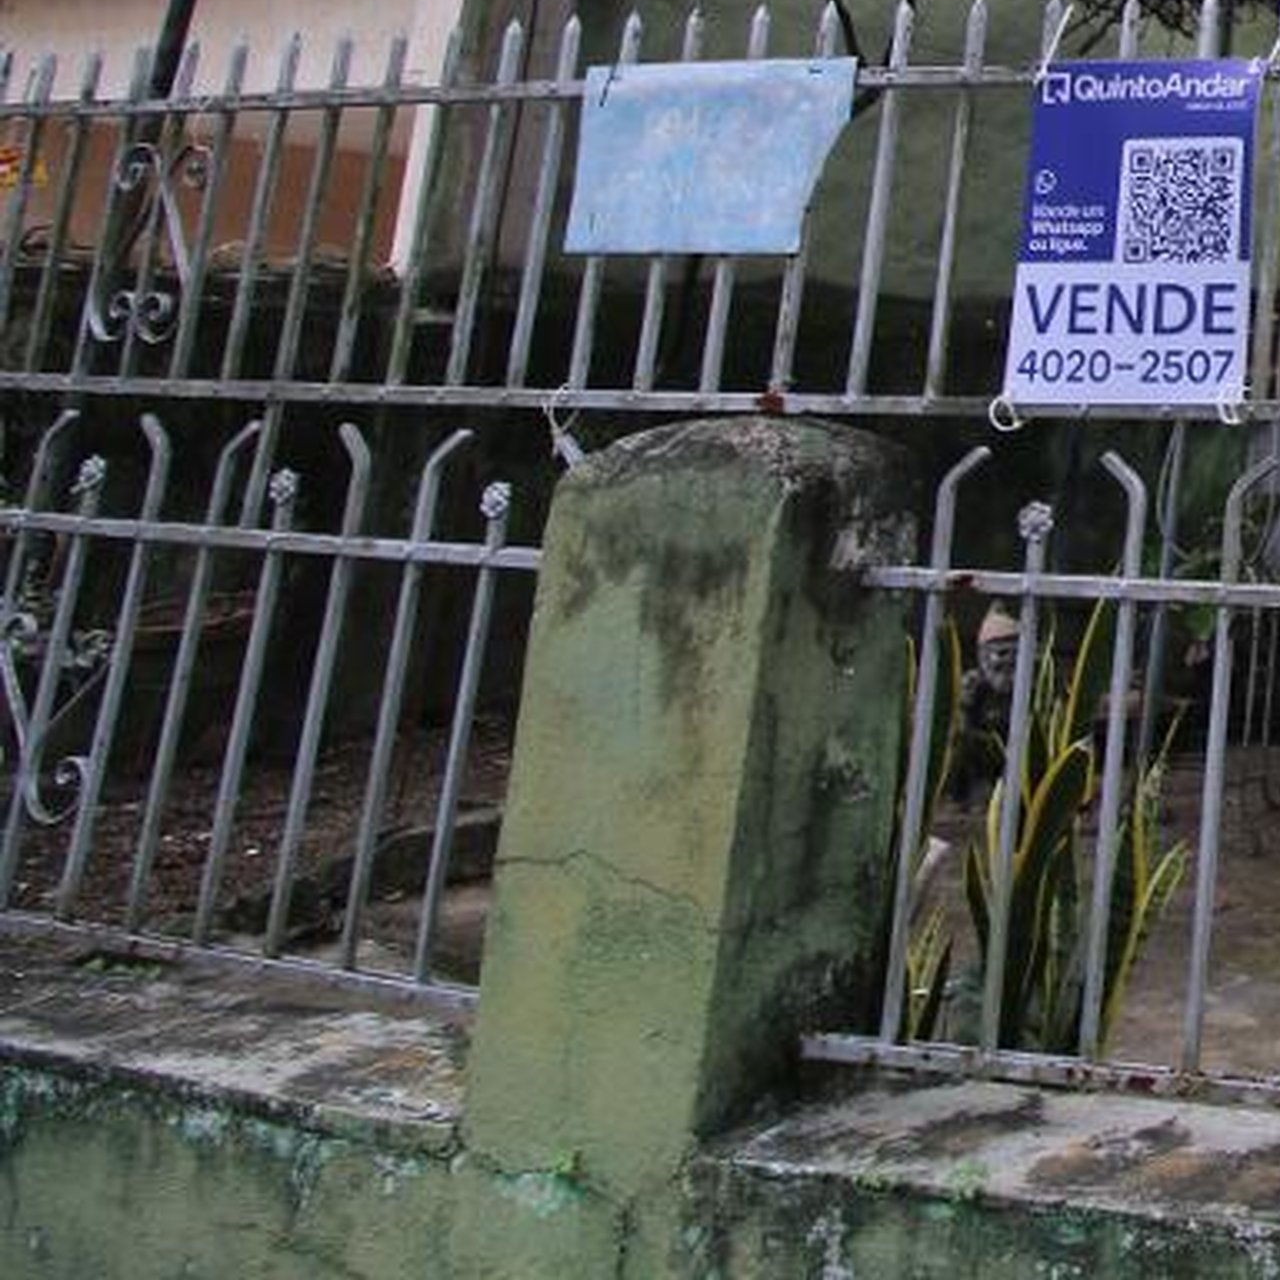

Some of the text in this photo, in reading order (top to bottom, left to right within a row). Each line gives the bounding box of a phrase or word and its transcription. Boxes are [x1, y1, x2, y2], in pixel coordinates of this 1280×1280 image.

[1074, 72, 1250, 102] QuintoAndar
[1026, 283, 1238, 335] VENDE
[1016, 349, 1235, 384] 4020-2507
